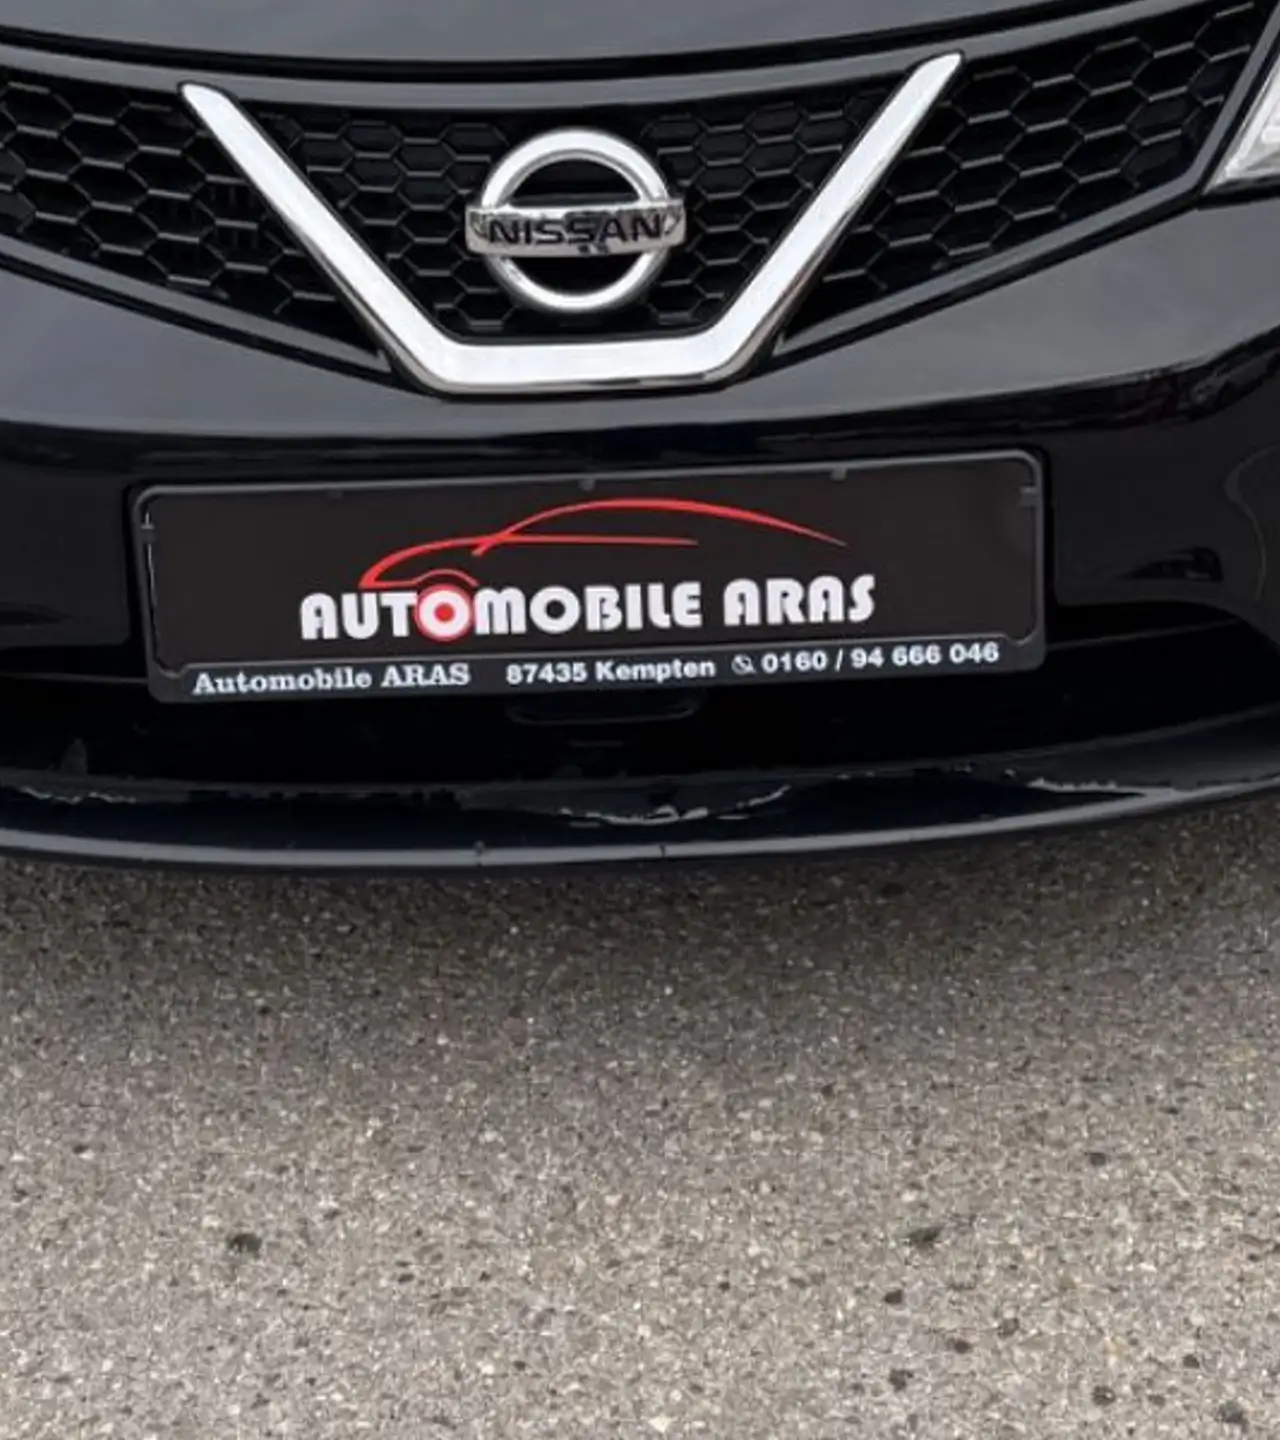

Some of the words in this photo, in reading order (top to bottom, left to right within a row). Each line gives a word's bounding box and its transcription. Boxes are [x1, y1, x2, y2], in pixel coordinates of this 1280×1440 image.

[488, 212, 662, 246] NISSAN
[300, 581, 701, 641] AUTOMOBILE
[723, 574, 875, 626] ARAS
[192, 665, 372, 695] Automobile
[380, 662, 471, 688] ARAS
[506, 662, 587, 685] 87435
[596, 658, 716, 687] Kempten
[761, 651, 827, 674] 0160
[851, 648, 885, 669] 94
[891, 644, 942, 667] 666
[949, 641, 1000, 664] 046
